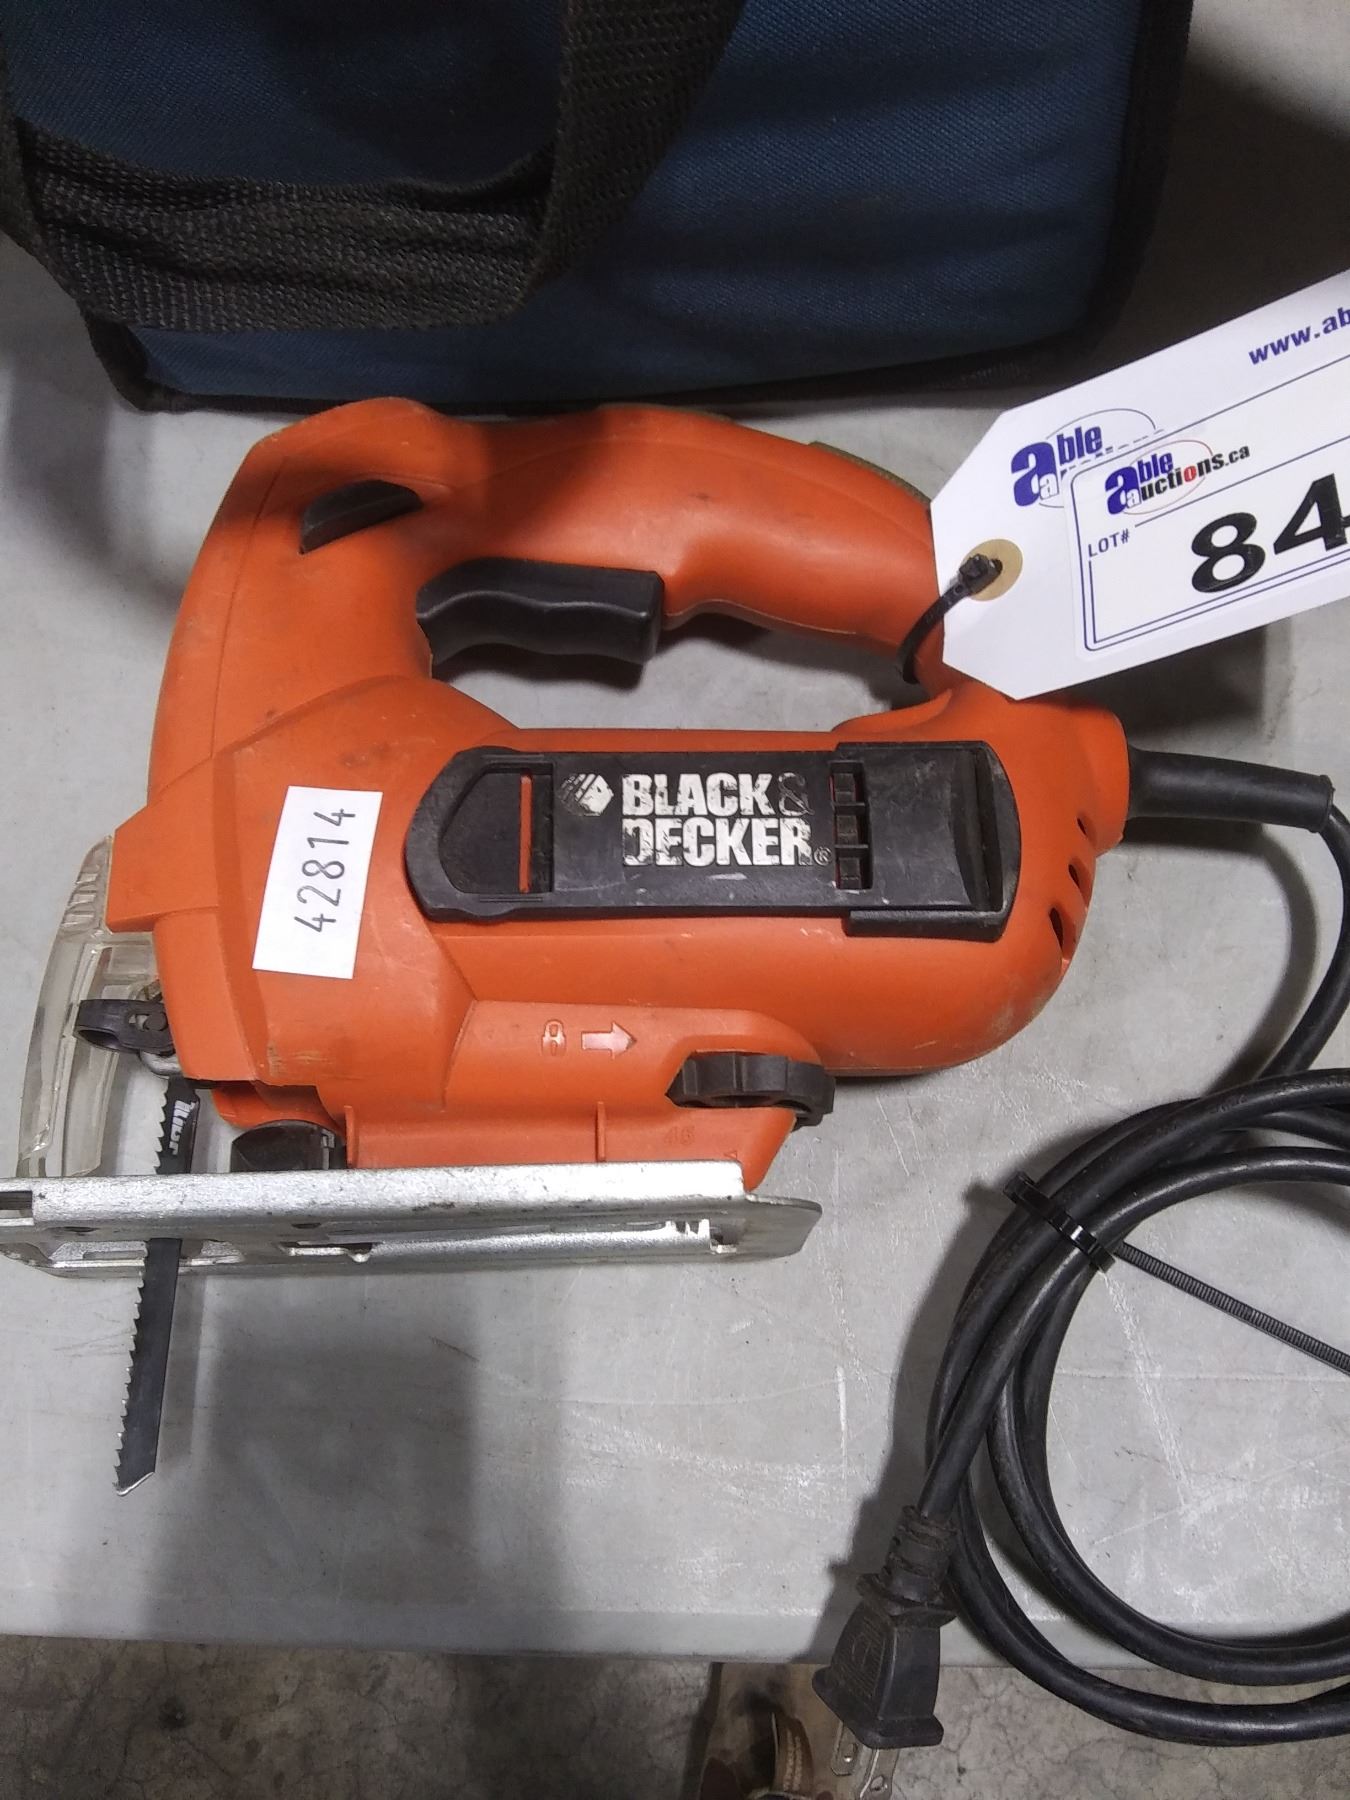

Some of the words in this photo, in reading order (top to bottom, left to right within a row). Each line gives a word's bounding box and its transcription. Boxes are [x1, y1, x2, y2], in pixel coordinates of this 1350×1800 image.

[1248, 306, 1350, 365] www.ab
[1010, 425, 1103, 507] able
[1105, 452, 1174, 515] able
[1088, 528, 1130, 558] LOT#
[294, 808, 356, 932] 42814
